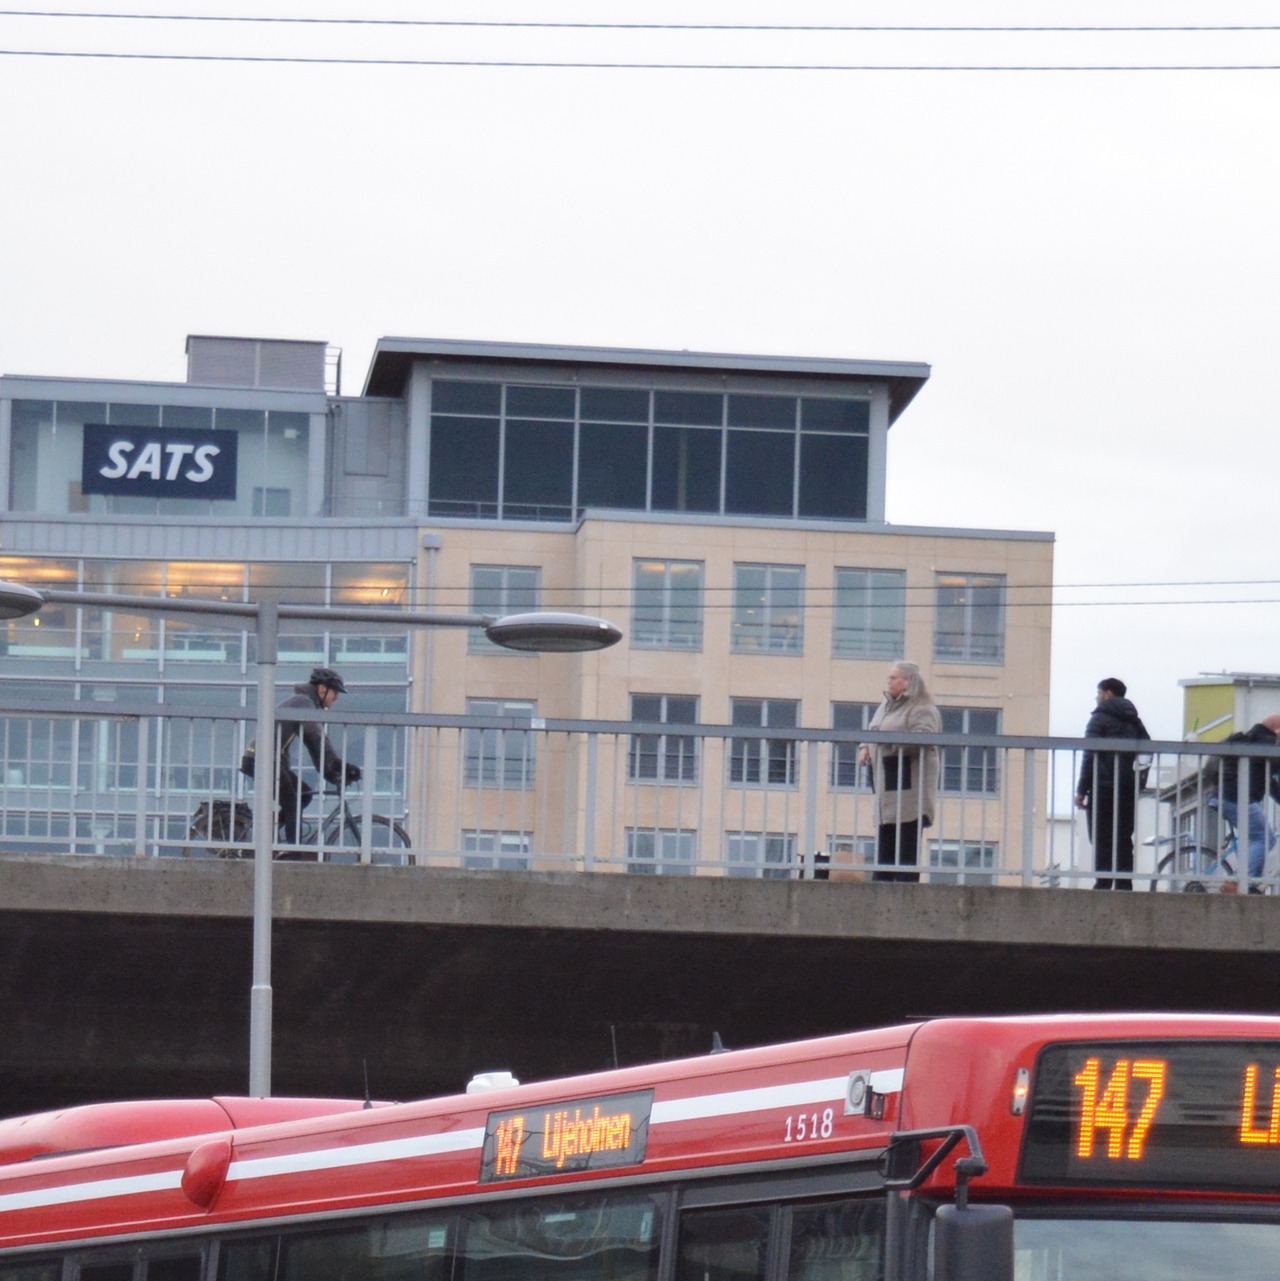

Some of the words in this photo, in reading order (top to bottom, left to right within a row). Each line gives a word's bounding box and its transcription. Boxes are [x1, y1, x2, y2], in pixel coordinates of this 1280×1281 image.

[99, 441, 221, 483] SATS
[784, 1108, 834, 1142] 1518
[1074, 1057, 1167, 1159] 147
[496, 1116, 524, 1175] 147
[543, 1106, 632, 1168] Liljeholmen
